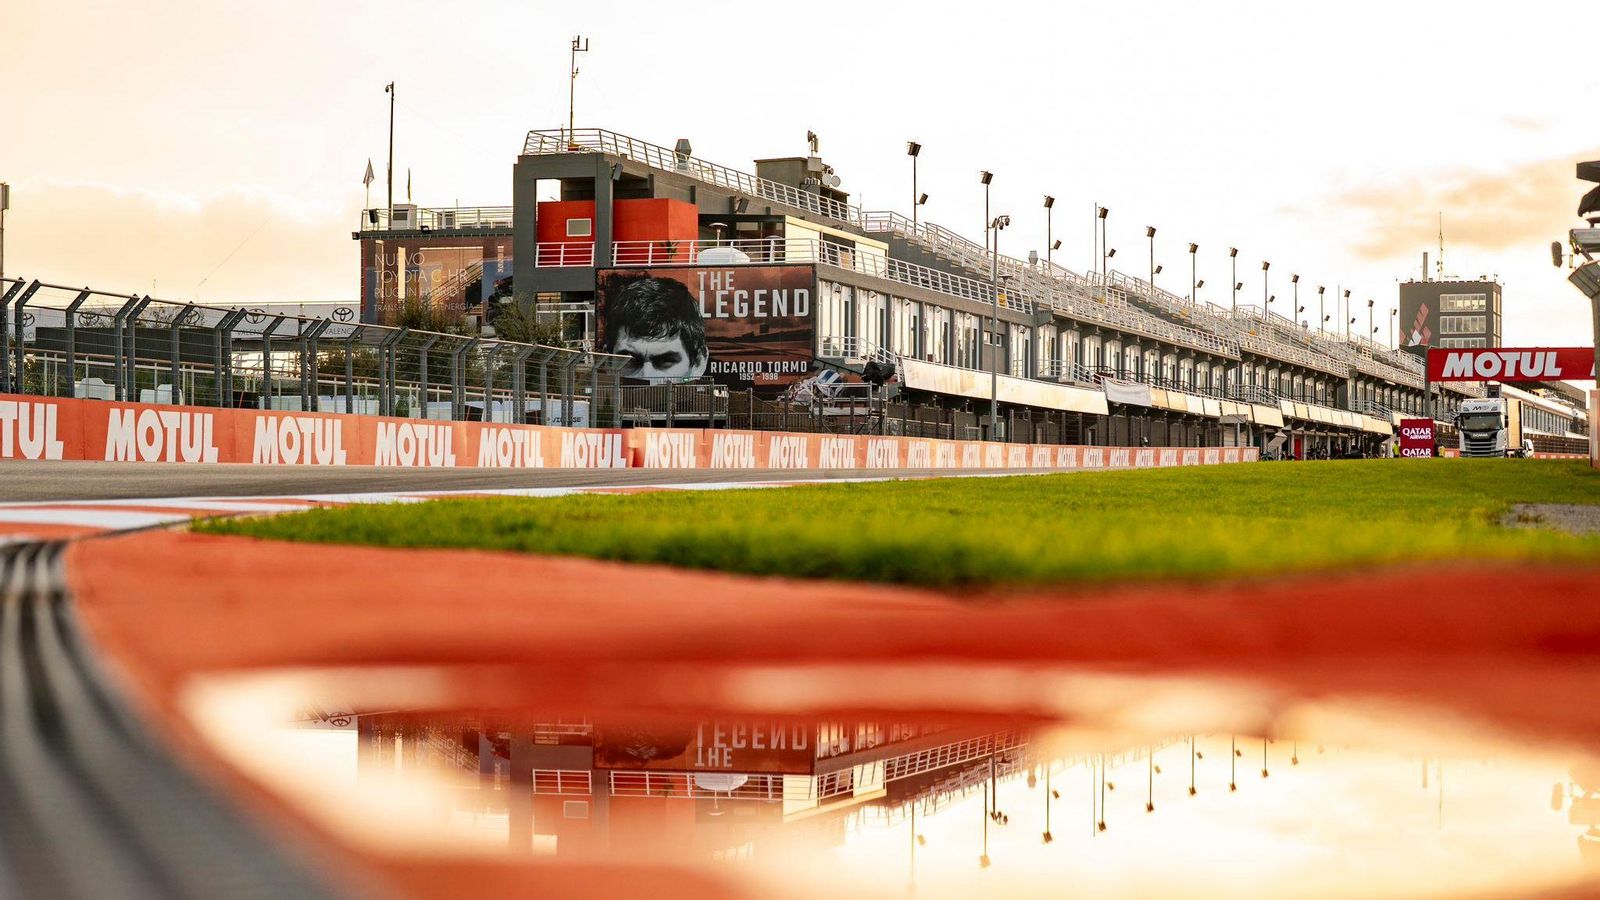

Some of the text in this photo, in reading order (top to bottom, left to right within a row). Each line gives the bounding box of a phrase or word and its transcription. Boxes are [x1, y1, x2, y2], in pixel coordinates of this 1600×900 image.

[374, 252, 424, 266] NUVO
[697, 271, 735, 290] THE
[699, 288, 809, 318] LEGEND
[711, 361, 807, 373] RICARDO TORMO
[1442, 352, 1562, 378] MOTUL
[740, 372, 755, 380] 1952
[105, 408, 219, 462] MOTUL
[253, 416, 346, 465] MOTUL
[375, 421, 455, 466] MOTUL
[477, 427, 544, 467] MOTUL
[560, 432, 626, 468] MOTUL
[1402, 427, 1431, 437] QATAR
[644, 432, 696, 468] MOTUL
[711, 434, 755, 468] MOTUL
[769, 436, 808, 468] MOTUL
[819, 438, 855, 468] MOTUL
[866, 439, 899, 468] MOTUL
[1402, 448, 1431, 457] QATAR
